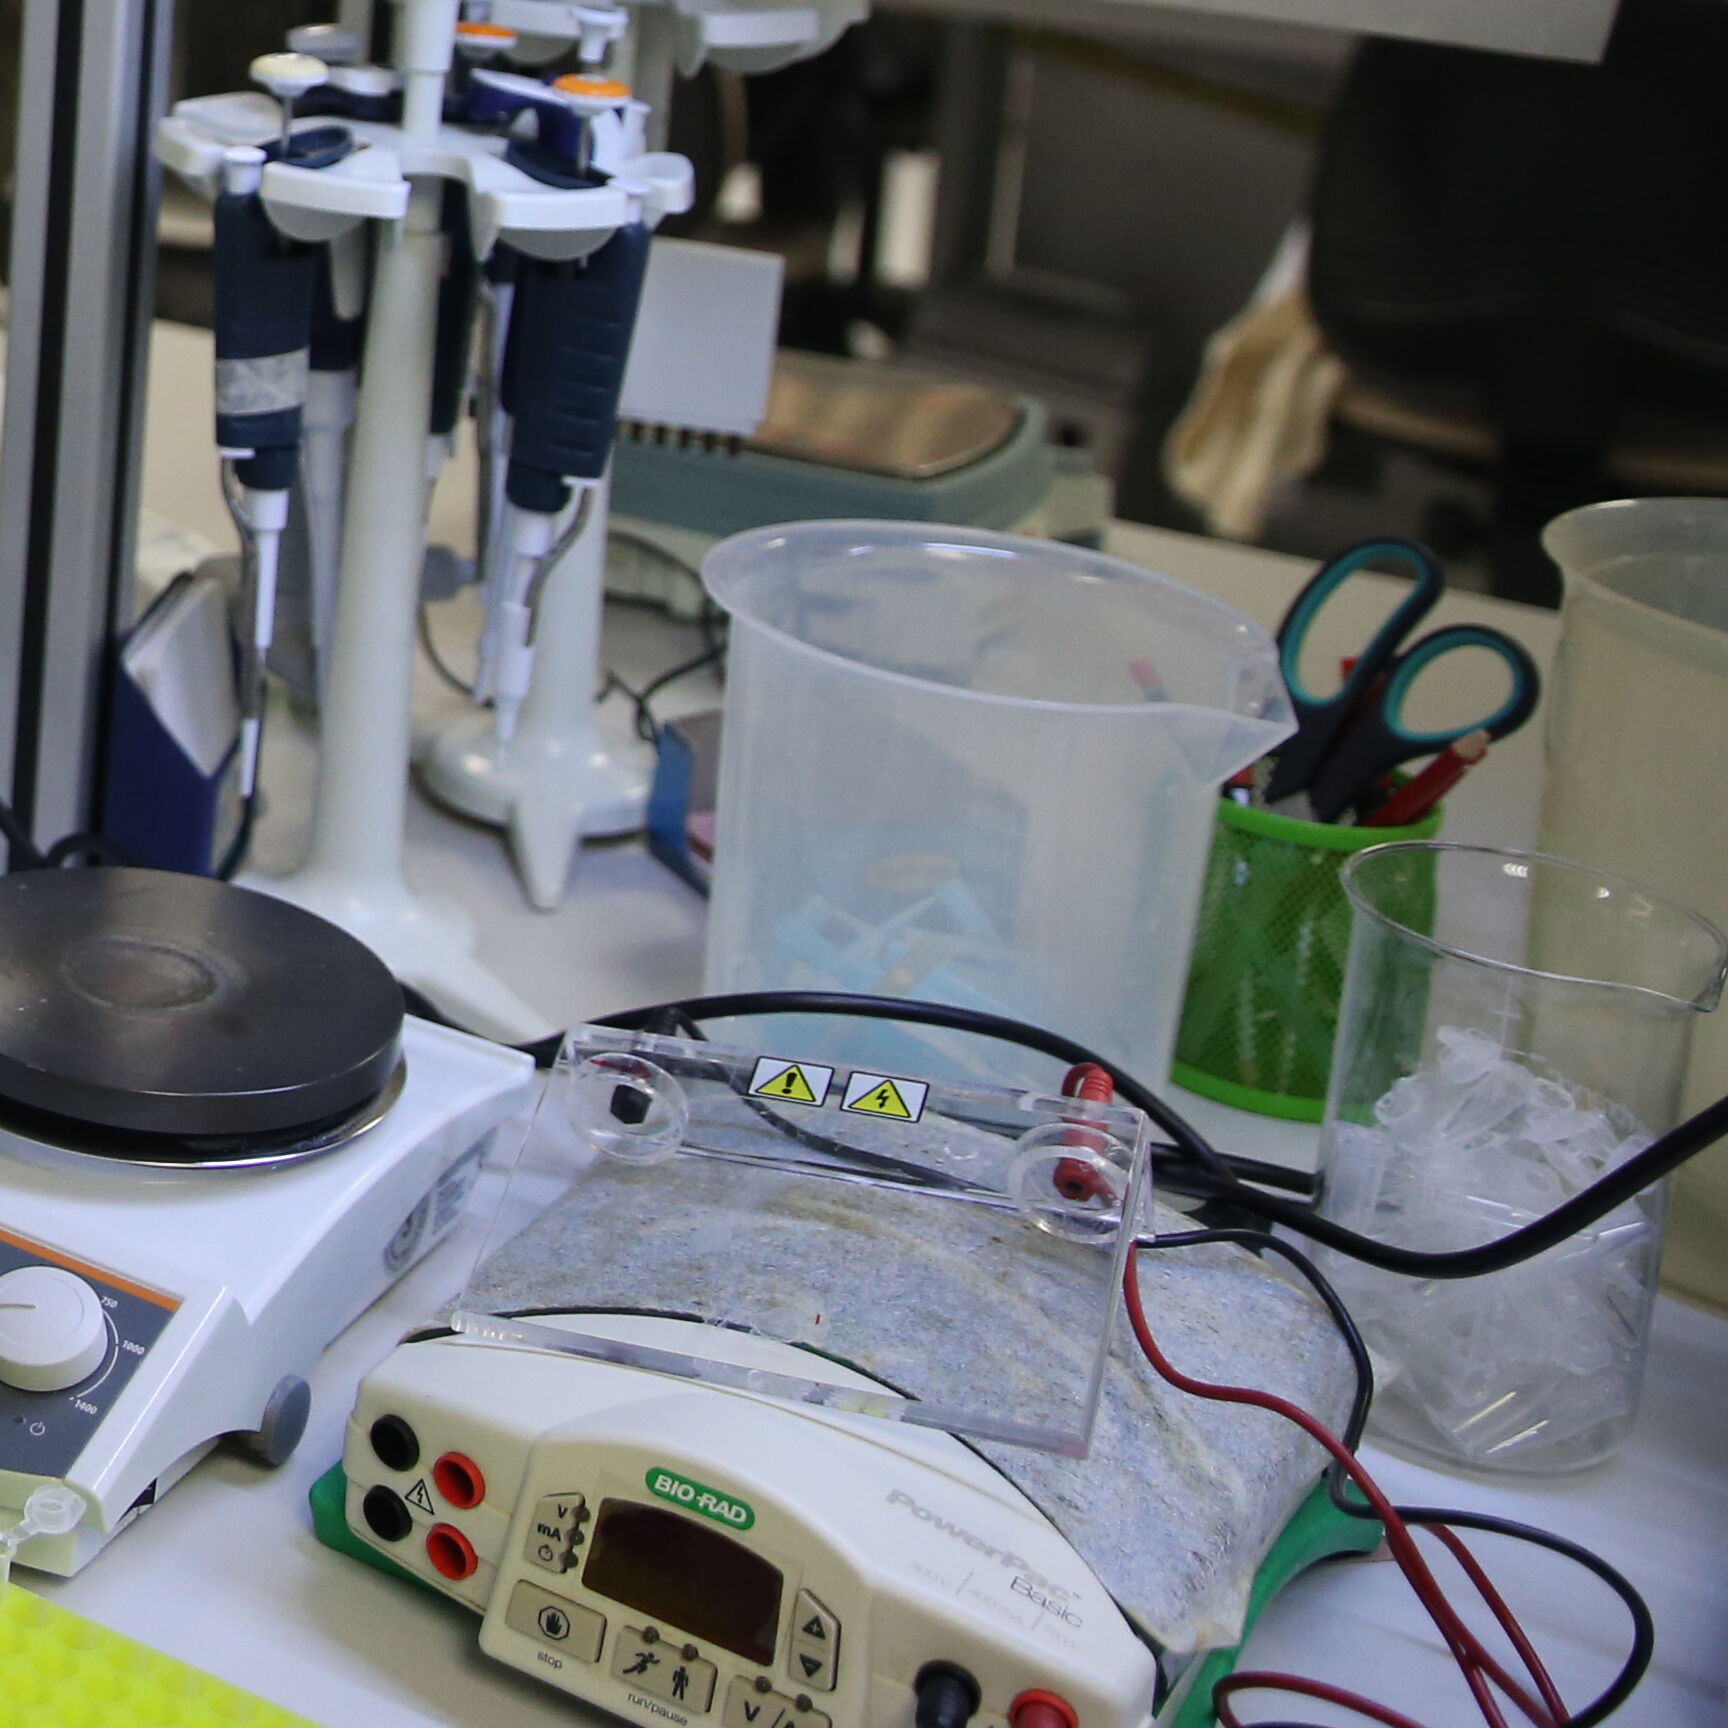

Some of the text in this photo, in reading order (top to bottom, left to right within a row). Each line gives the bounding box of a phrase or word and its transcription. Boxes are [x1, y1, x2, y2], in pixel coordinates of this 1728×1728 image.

[100, 1295, 118, 1309] 750
[121, 1339, 145, 1356] 1000
[74, 1398, 97, 1415] 1400
[557, 1503, 569, 1519] V
[537, 1522, 562, 1542] mA
[1009, 1575, 1083, 1629] Basic
[537, 1649, 564, 1670] stop
[627, 1690, 688, 1726] run/pause
